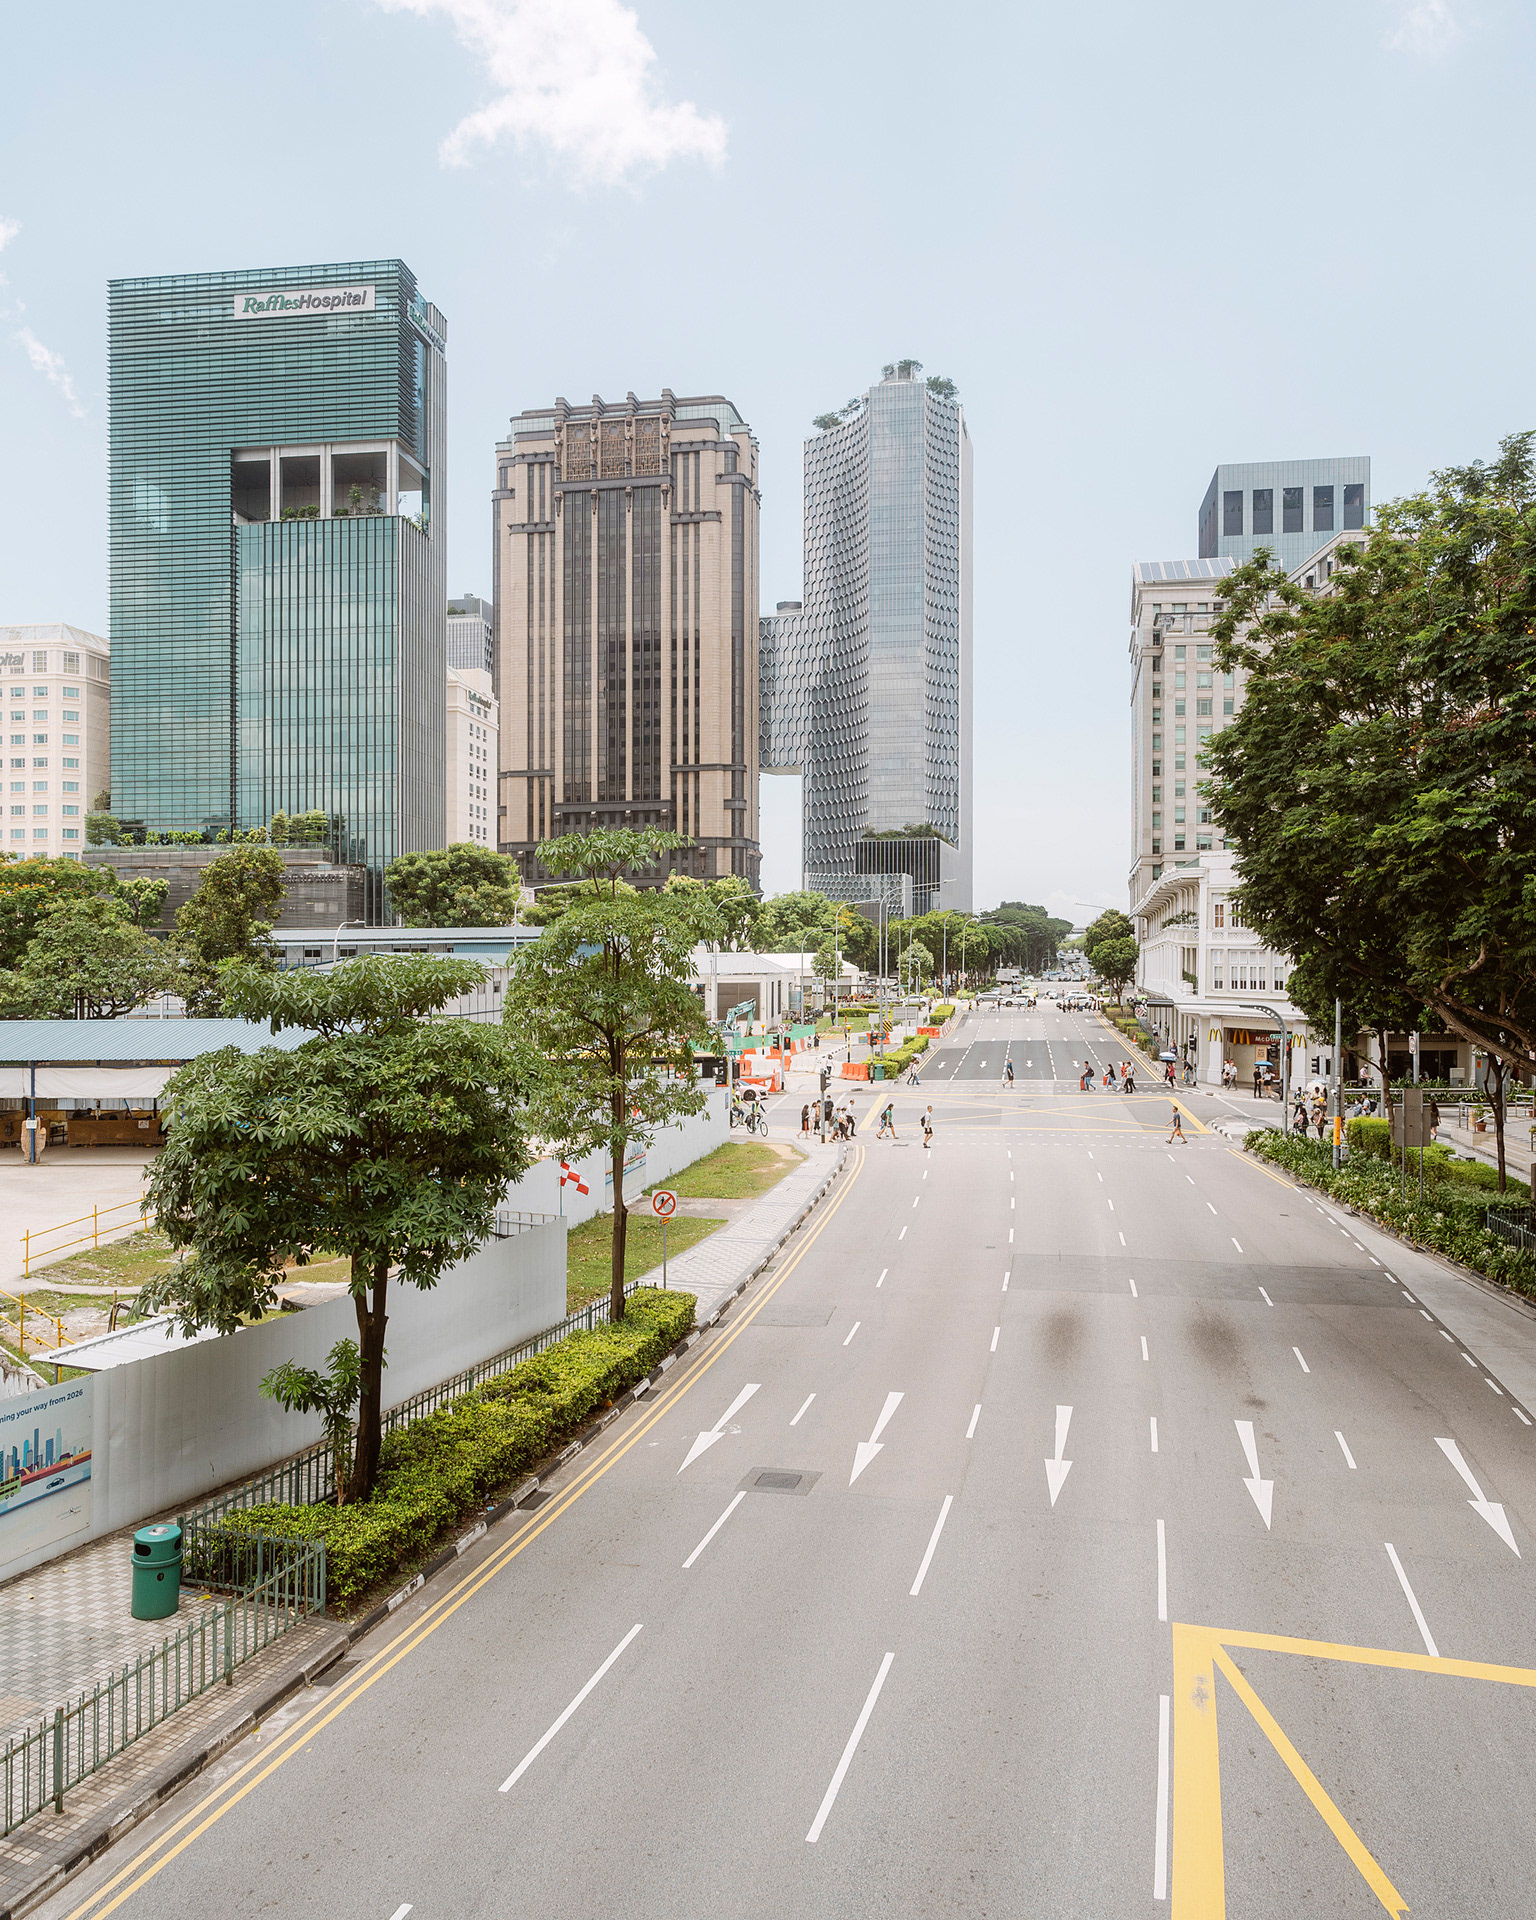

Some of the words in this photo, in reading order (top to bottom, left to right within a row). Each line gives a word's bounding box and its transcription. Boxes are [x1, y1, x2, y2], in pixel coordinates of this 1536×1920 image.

[16, 1407, 32, 1419] your
[33, 1402, 48, 1411] way
[49, 1396, 66, 1406] from
[67, 1388, 84, 1400] 2026
